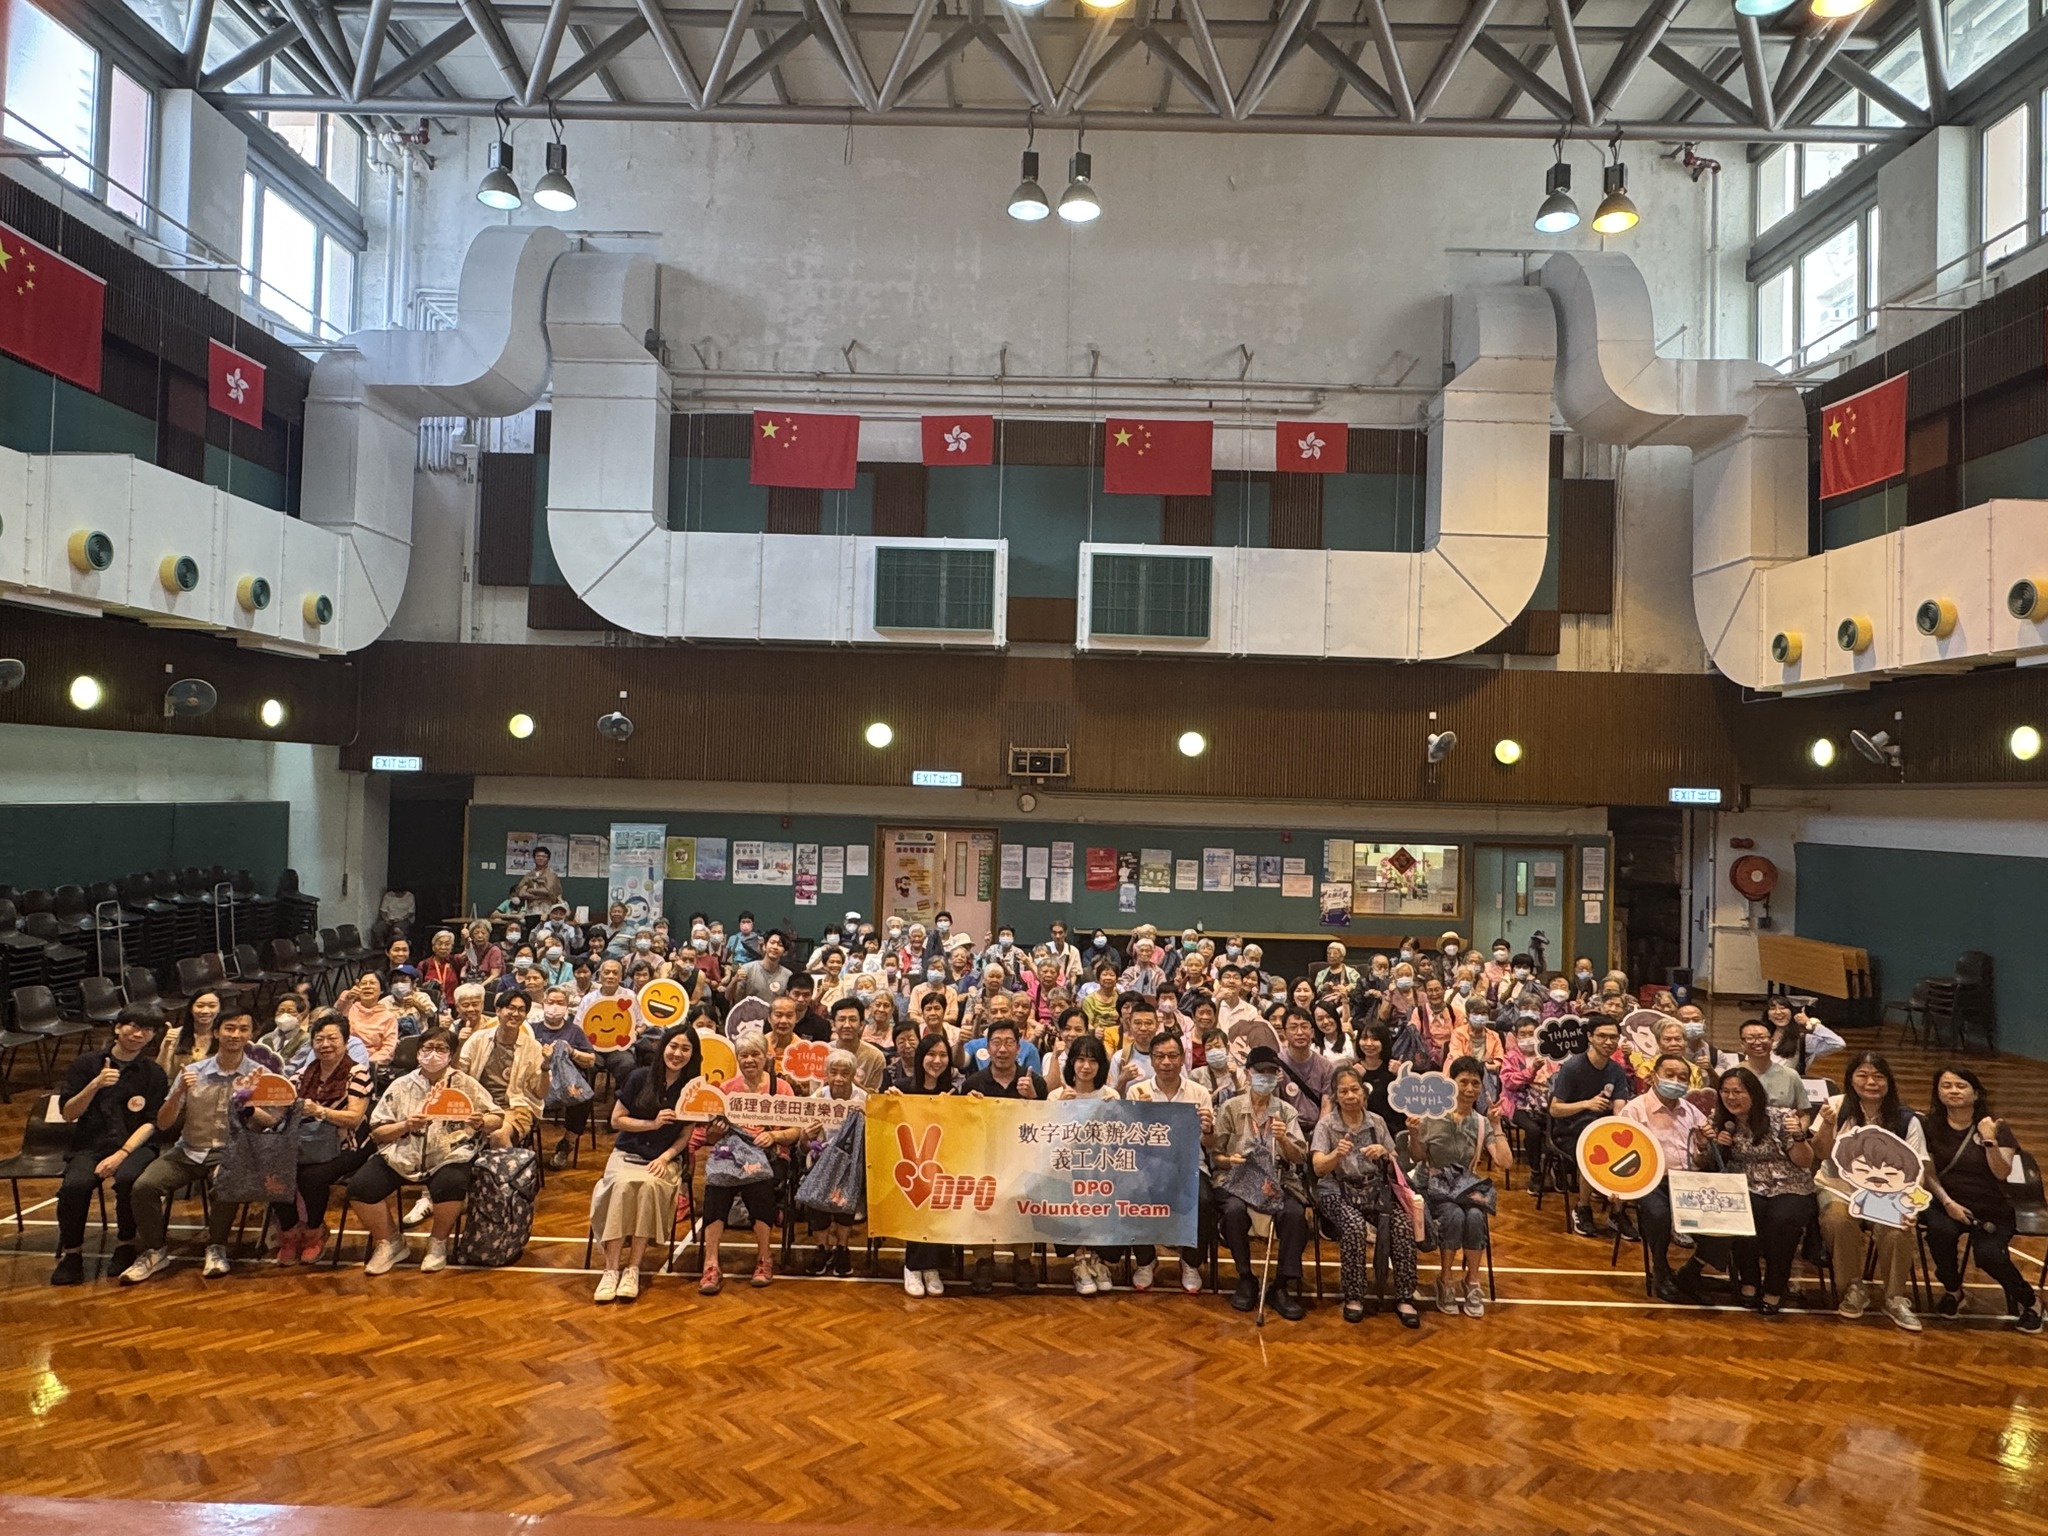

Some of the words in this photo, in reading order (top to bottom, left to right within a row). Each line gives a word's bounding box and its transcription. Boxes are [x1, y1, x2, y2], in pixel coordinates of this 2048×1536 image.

[375, 758, 396, 768] EXIT
[398, 759, 417, 769] 出口
[916, 773, 938, 784] EXIT
[939, 774, 959, 784] 出口
[1674, 790, 1696, 801] EXIT
[1697, 790, 1718, 801] 出口
[1548, 1027, 1583, 1041] THANK
[1557, 1040, 1579, 1051] YOU
[796, 1052, 827, 1061] THAN
[802, 1062, 823, 1071] YOU
[1411, 1084, 1435, 1093] YOU
[1404, 1096, 1443, 1106] THANK
[775, 1115, 798, 1123] Church
[1018, 1121, 1171, 1146] 數字政策辦公室
[1050, 1149, 1137, 1171] 義工小組
[930, 1175, 997, 1211] DPO
[1073, 1180, 1114, 1196] DPO
[1017, 1200, 1110, 1216] Volunteer
[1115, 1200, 1170, 1217] Team
